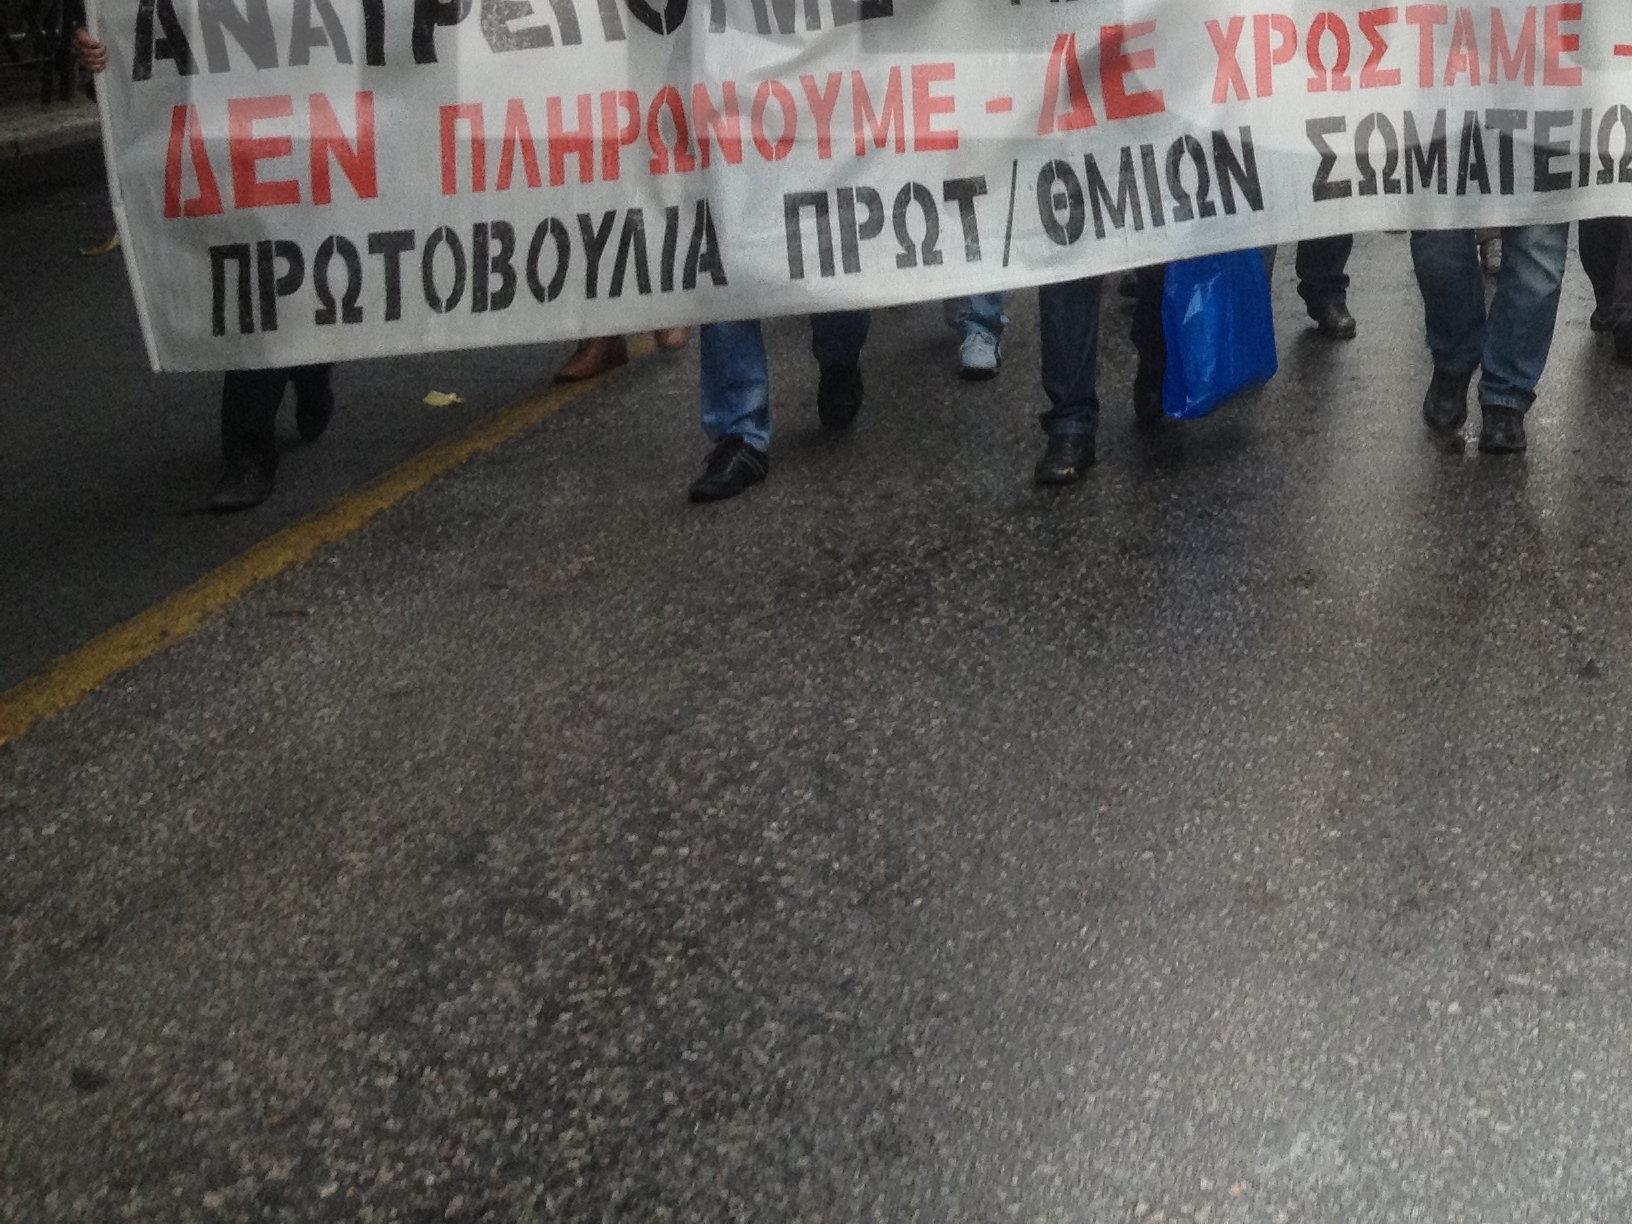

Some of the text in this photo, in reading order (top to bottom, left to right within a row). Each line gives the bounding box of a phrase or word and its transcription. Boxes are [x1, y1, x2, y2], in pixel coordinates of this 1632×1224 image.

[162, 90, 379, 219] ΔΕΝ
[439, 62, 959, 197] ΠΛΗΡΩΝΟΥΜΕ
[1036, 20, 1167, 136] ΔΕ
[1205, 2, 1583, 105] ΧΡΩΣΤΑΜΕ
[209, 197, 728, 337] ΠΡΩΤΟΒΟΥΛΙΑ
[783, 126, 1264, 280] ΠΡΩΤ/ΘΜΙΩΝ
